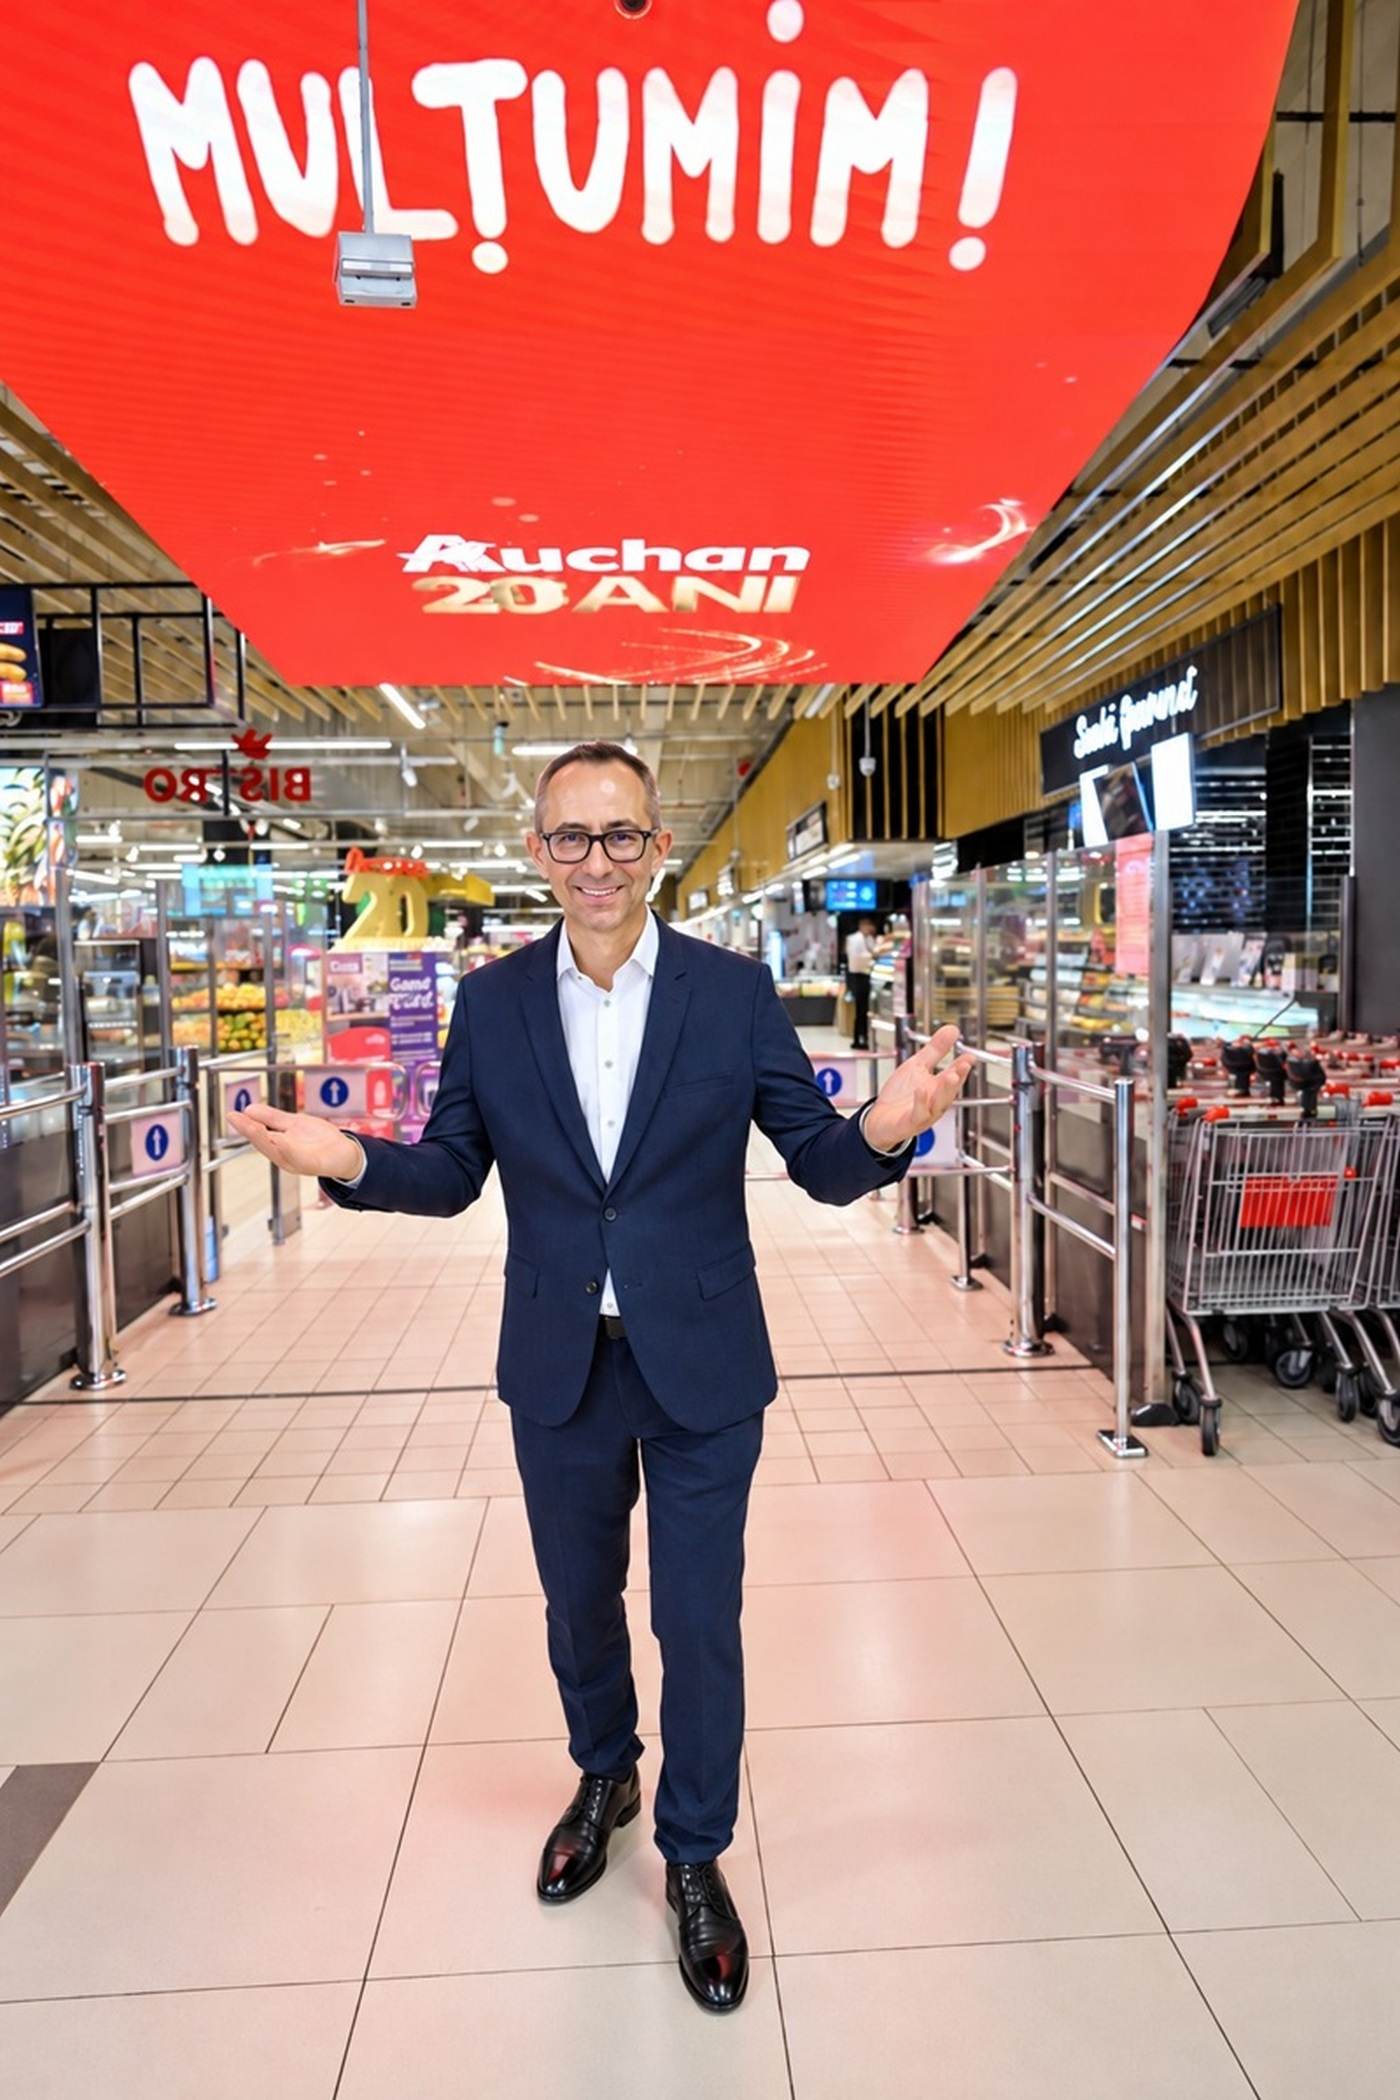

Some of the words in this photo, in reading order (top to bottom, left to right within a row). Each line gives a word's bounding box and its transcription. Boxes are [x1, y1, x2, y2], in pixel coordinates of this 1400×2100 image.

[397, 534, 811, 573] Auchan
[412, 576, 568, 614] 20
[573, 576, 800, 614] ANI
[342, 872, 430, 939] 20
